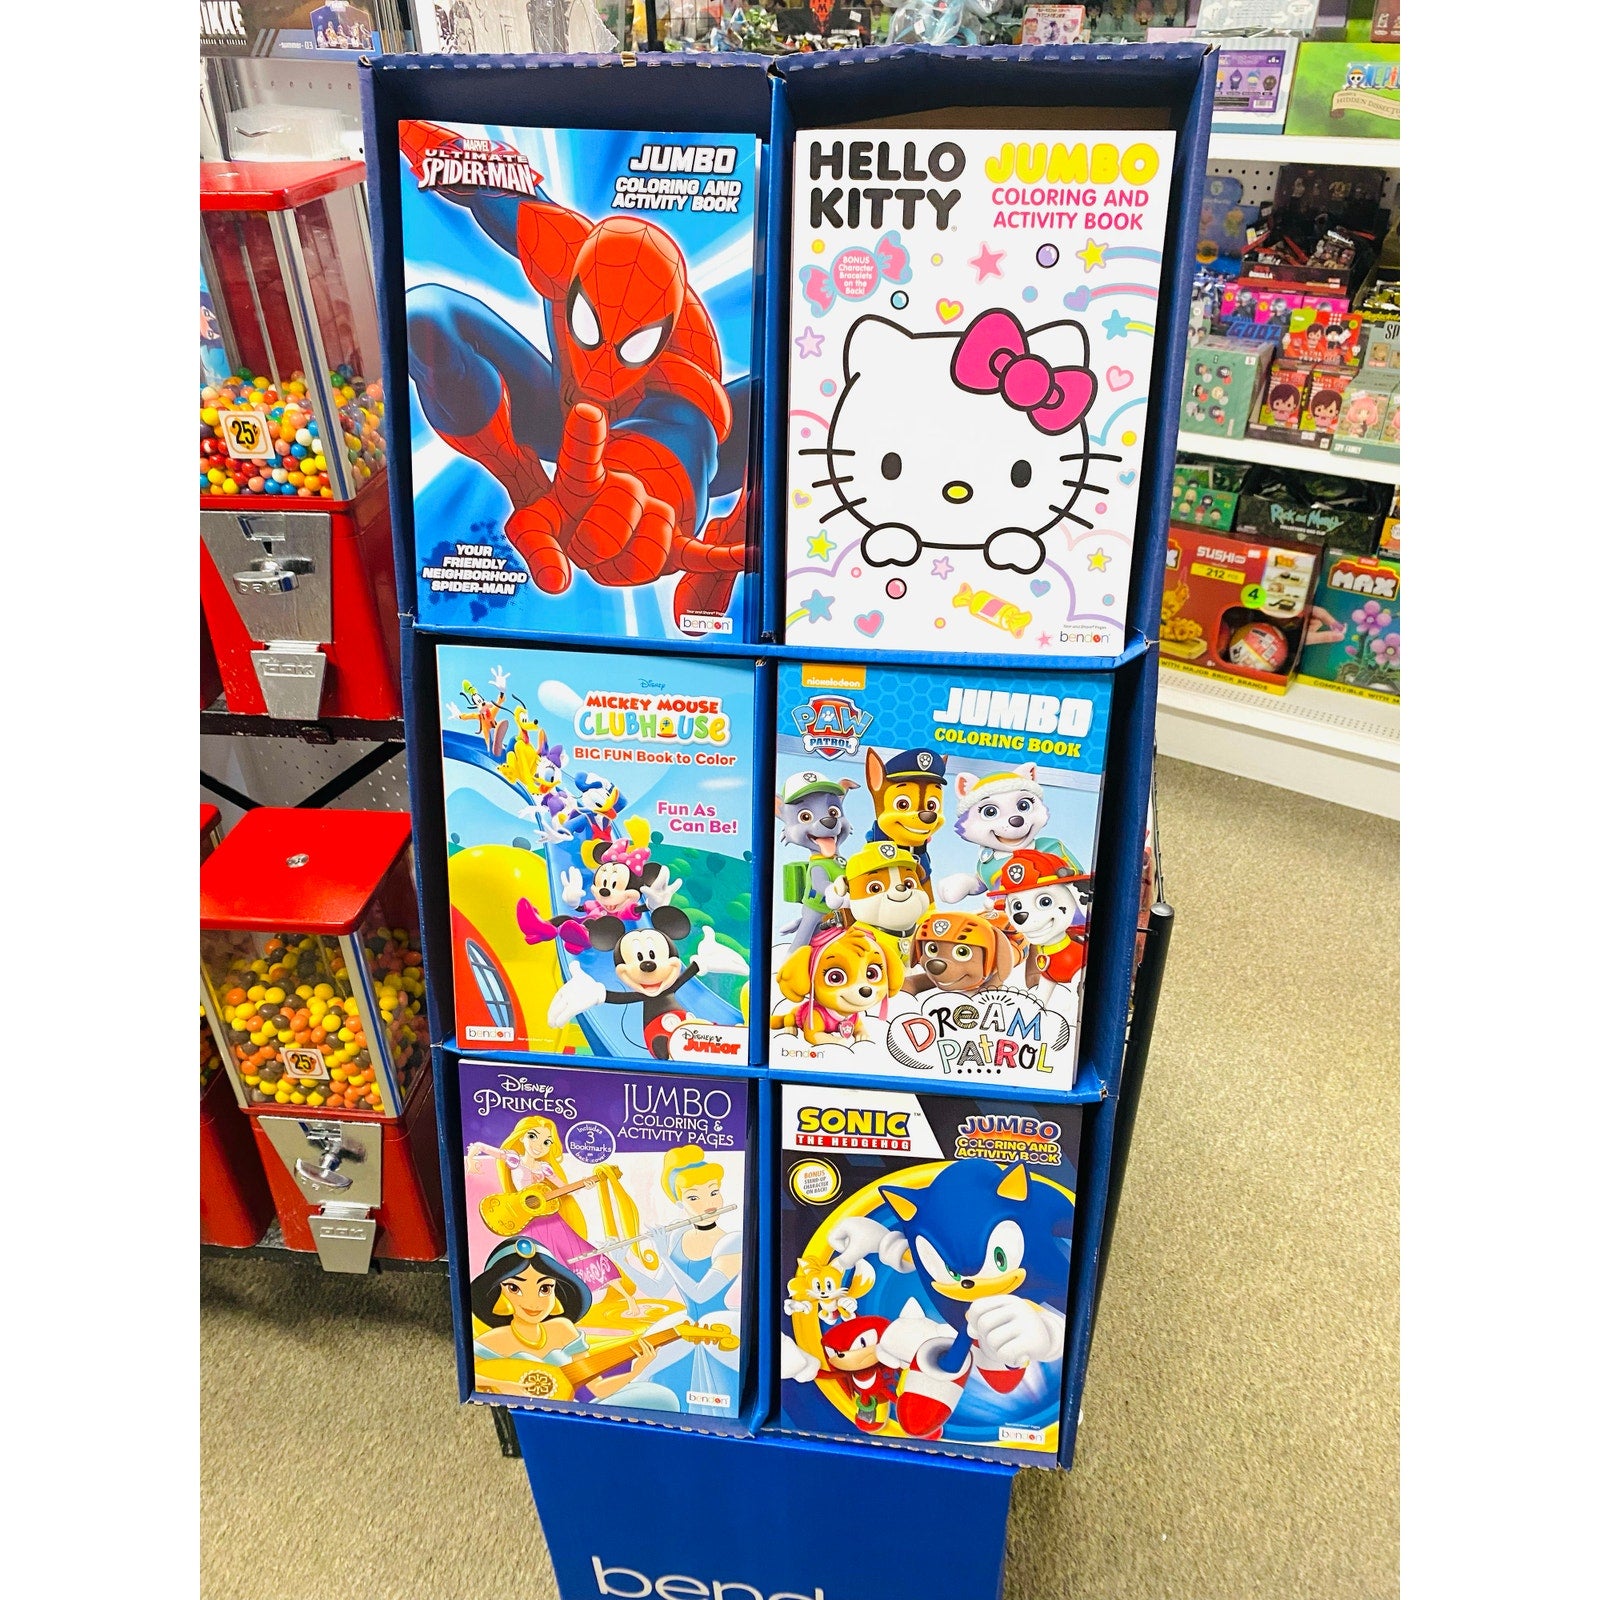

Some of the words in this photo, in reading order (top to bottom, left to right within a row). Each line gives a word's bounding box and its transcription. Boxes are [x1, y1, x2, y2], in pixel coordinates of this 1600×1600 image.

[200, 1, 246, 35] IKKE
[463, 139, 491, 152] MARVEL
[425, 149, 529, 163] ULTIMATE
[629, 144, 738, 174] JUMBO
[810, 141, 966, 182] HELLO
[985, 142, 1160, 186] JUMBO
[418, 157, 537, 196] SPIDER-MAN
[615, 176, 700, 195] COLORING
[702, 180, 742, 197] AND
[611, 192, 689, 211] ACTIVITY
[691, 195, 740, 213] BOOK
[992, 187, 1097, 207] COLORING
[1103, 189, 1149, 207] AND
[810, 187, 962, 231] KITTY
[993, 211, 1078, 230] ACTIVITY
[1084, 212, 1144, 230] BOOK
[839, 271, 873, 279] Bracelets
[855, 279, 867, 287] the
[845, 287, 865, 295] Back!
[456, 544, 493, 557] YOUR
[1197, 545, 1236, 564] SUSHI
[443, 557, 507, 570] FRIENDLY
[422, 567, 528, 583] NEIGHBORHOOD
[1206, 567, 1226, 579] 212
[431, 580, 515, 595] SPIDER-MAN
[1331, 569, 1396, 598] MAX
[1247, 588, 1259, 600] 4
[683, 617, 729, 631] bendon
[1060, 630, 1109, 644] bendon
[638, 678, 666, 691] Disney
[806, 676, 861, 688] nickelodeon
[1313, 680, 1364, 697] COMPATIBLE
[586, 695, 652, 711] MICKEY
[657, 699, 719, 714] MOUSE
[933, 687, 1094, 738] JUMBO
[791, 704, 874, 738] PAW
[809, 737, 852, 749] PATROL
[934, 727, 1025, 751] COLORING
[1027, 738, 1082, 758] BOOK
[575, 747, 600, 760] BIG
[604, 749, 632, 761] FUN
[636, 751, 673, 764] Book
[676, 752, 691, 765] to
[695, 753, 737, 765] Color
[658, 802, 689, 816] Fun
[693, 803, 716, 817] As
[669, 818, 704, 833] Can
[709, 820, 738, 834] Be!
[469, 1028, 511, 1039] bendon
[680, 1027, 715, 1042] Disney
[781, 1047, 825, 1059] bendon
[498, 1074, 554, 1097] Disney
[623, 1083, 732, 1123] JUMBO
[632, 1114, 709, 1134] COLORING
[713, 1120, 723, 1132] &
[797, 1106, 911, 1138] SONIC
[958, 1115, 1061, 1142] JUMBO
[585, 1130, 595, 1144] 3
[616, 1125, 683, 1144] ACTIVITY
[687, 1132, 735, 1147] PAGES
[797, 1135, 824, 1146] THE
[831, 1137, 910, 1150] HEDGEHOG
[570, 1141, 612, 1153] Bookmarks
[958, 1138, 1026, 1151] COLORING
[1029, 1142, 1058, 1153] AND
[957, 1148, 1018, 1161] ACTIVITY
[1019, 1151, 1060, 1164] BOOK
[804, 1170, 825, 1179] BONUS
[688, 1393, 729, 1405] bendon
